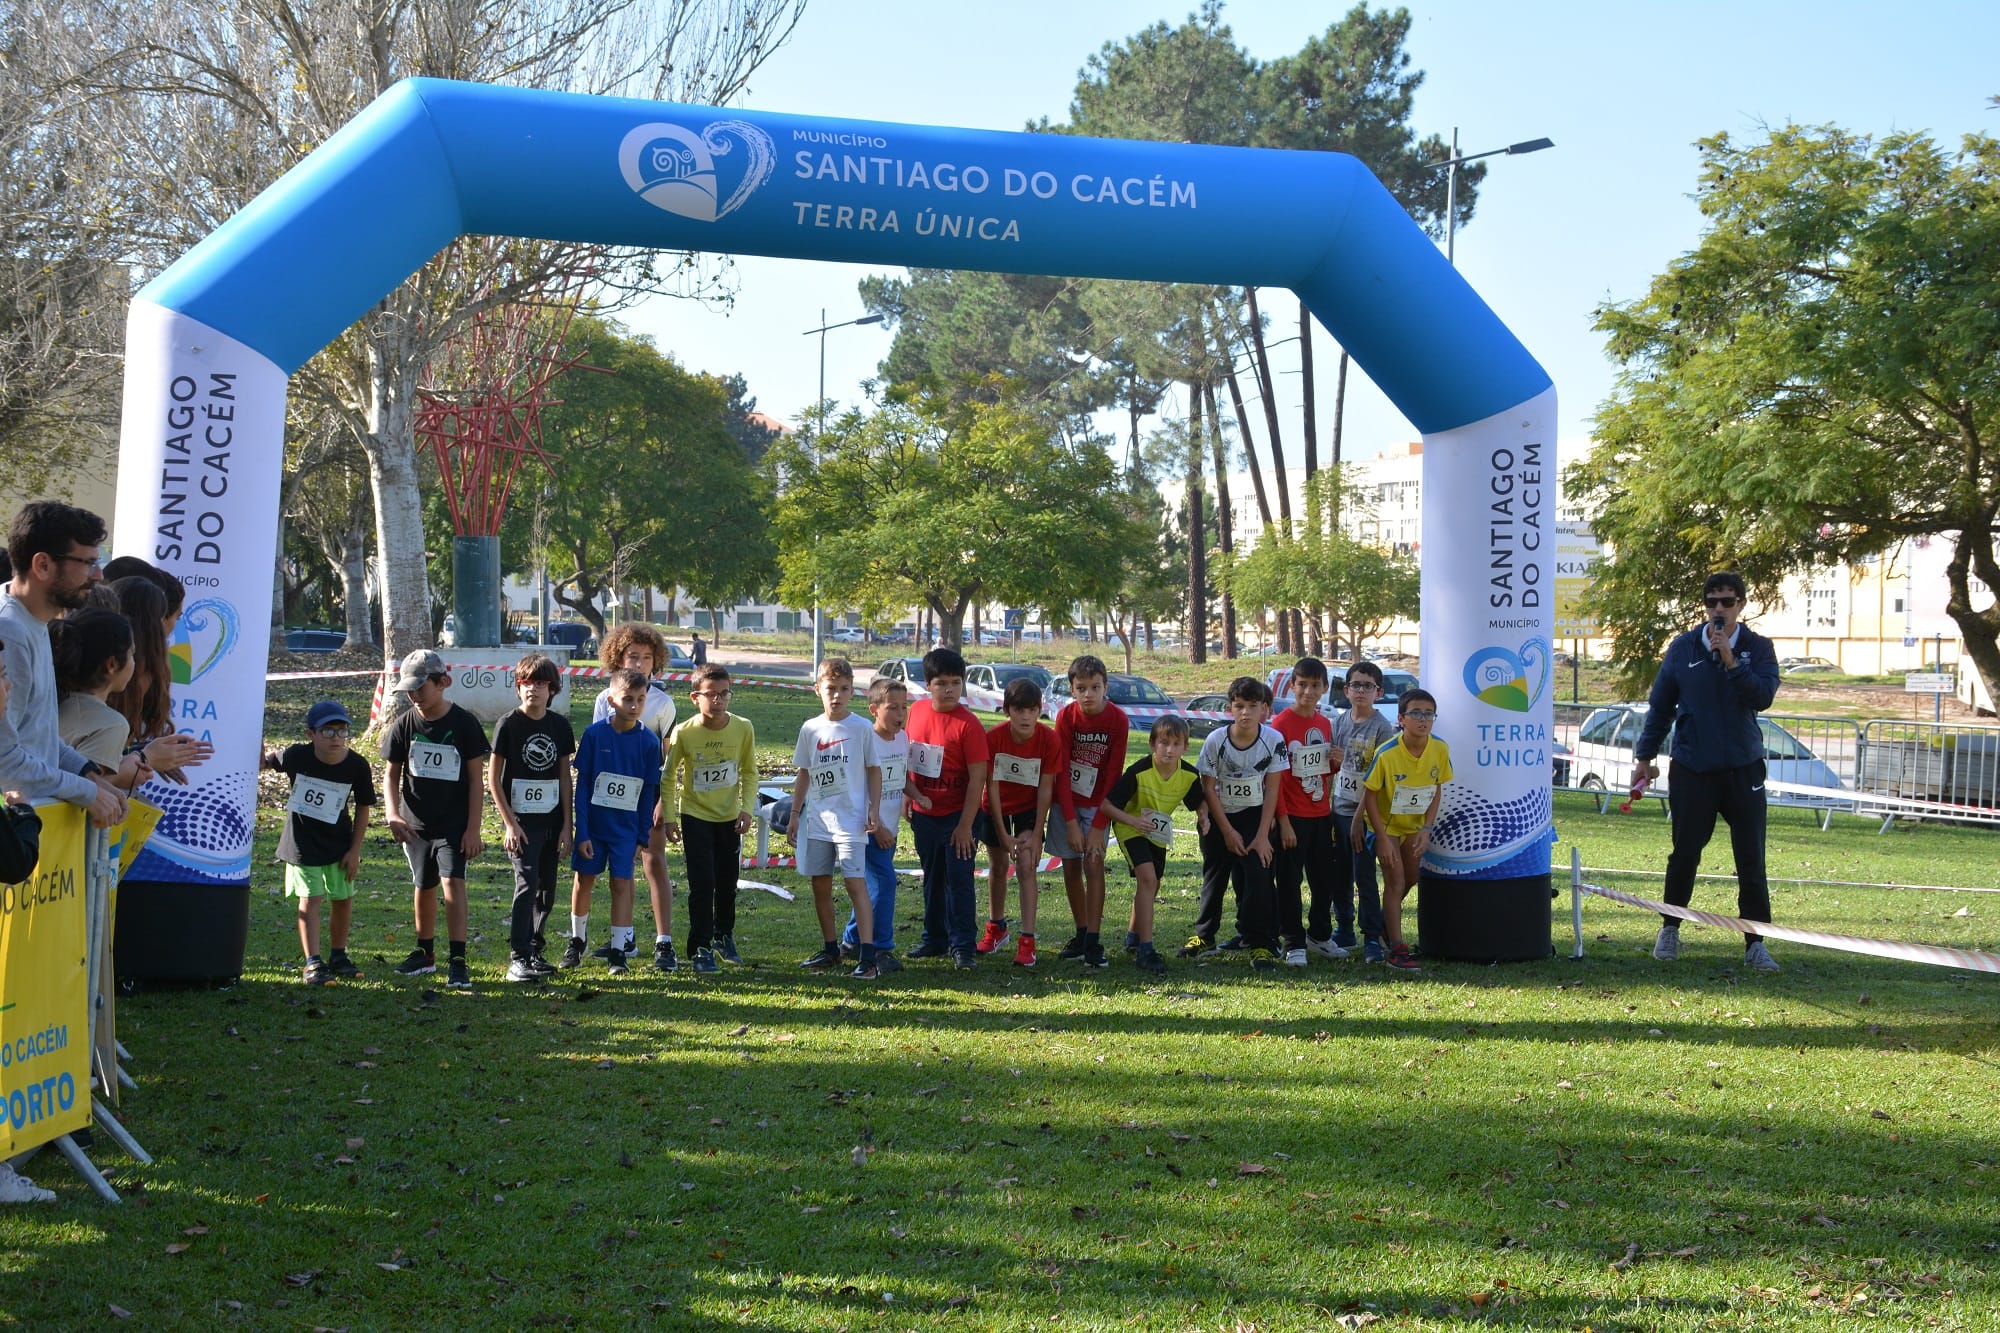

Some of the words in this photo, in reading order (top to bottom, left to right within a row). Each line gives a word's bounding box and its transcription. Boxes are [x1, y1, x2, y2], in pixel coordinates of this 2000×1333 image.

[792, 129, 887, 149] MUNICÍPIO
[794, 150, 990, 195] SANTIAGO
[1003, 168, 1058, 199] DO
[1071, 173, 1198, 209] CACÉM
[792, 201, 900, 233] TERRA
[914, 207, 1022, 242] ÚNICA
[200, 373, 237, 498] CACÉM
[155, 375, 197, 561] SANTIAGO
[1518, 443, 1541, 551] CACÉM
[1489, 448, 1514, 608] SANTIAGO
[193, 511, 224, 564] DO
[1521, 563, 1540, 608] DO
[1488, 618, 1540, 629] MUNICÍPIO
[1075, 731, 1108, 743] URBAN
[1476, 723, 1546, 742] TERRA
[423, 751, 443, 766] 70
[919, 750, 925, 763] 8
[1301, 751, 1321, 767] 130
[1476, 746, 1545, 767] ÚNICA
[702, 767, 729, 782] 127
[886, 766, 893, 780] 7
[1011, 762, 1020, 773] 6
[814, 770, 835, 787] 129
[1340, 775, 1358, 792] 124
[304, 789, 326, 806] 65
[525, 788, 543, 801] 66
[607, 782, 626, 797] 68
[1226, 784, 1252, 797] 128
[1410, 794, 1419, 806] 5
[21, 863, 75, 911] CACÉM
[16, 1023, 68, 1063] CACÉM
